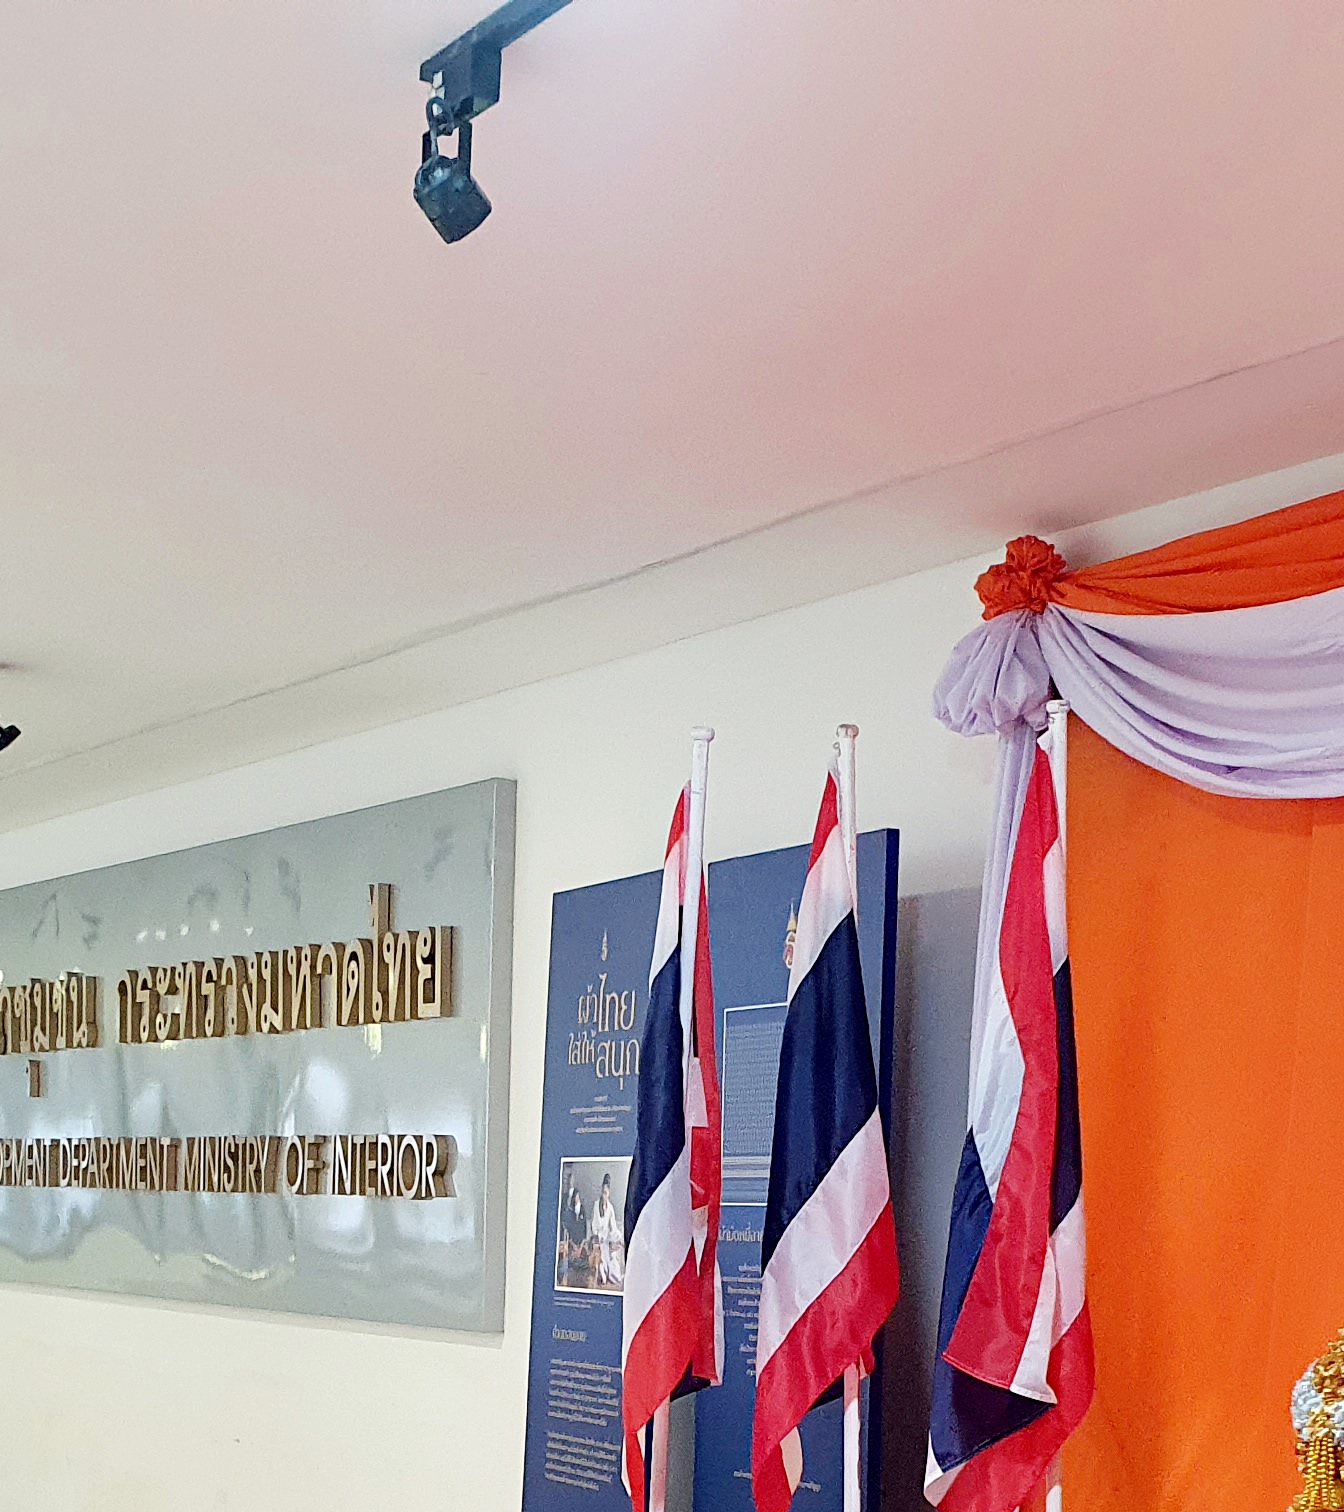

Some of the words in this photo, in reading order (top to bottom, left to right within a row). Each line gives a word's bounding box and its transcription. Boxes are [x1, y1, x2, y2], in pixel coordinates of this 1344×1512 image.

[116, 883, 449, 1043] กระทรวงมหาดไทย
[577, 972, 636, 1032] ผ้าไทย
[568, 1028, 640, 1091] ใส่ให้สนุก
[59, 1137, 171, 1191] DEPARTMENT
[183, 1136, 270, 1192] MINISTRY
[286, 1135, 325, 1196] OF
[331, 1134, 440, 1200] INTERIOR
